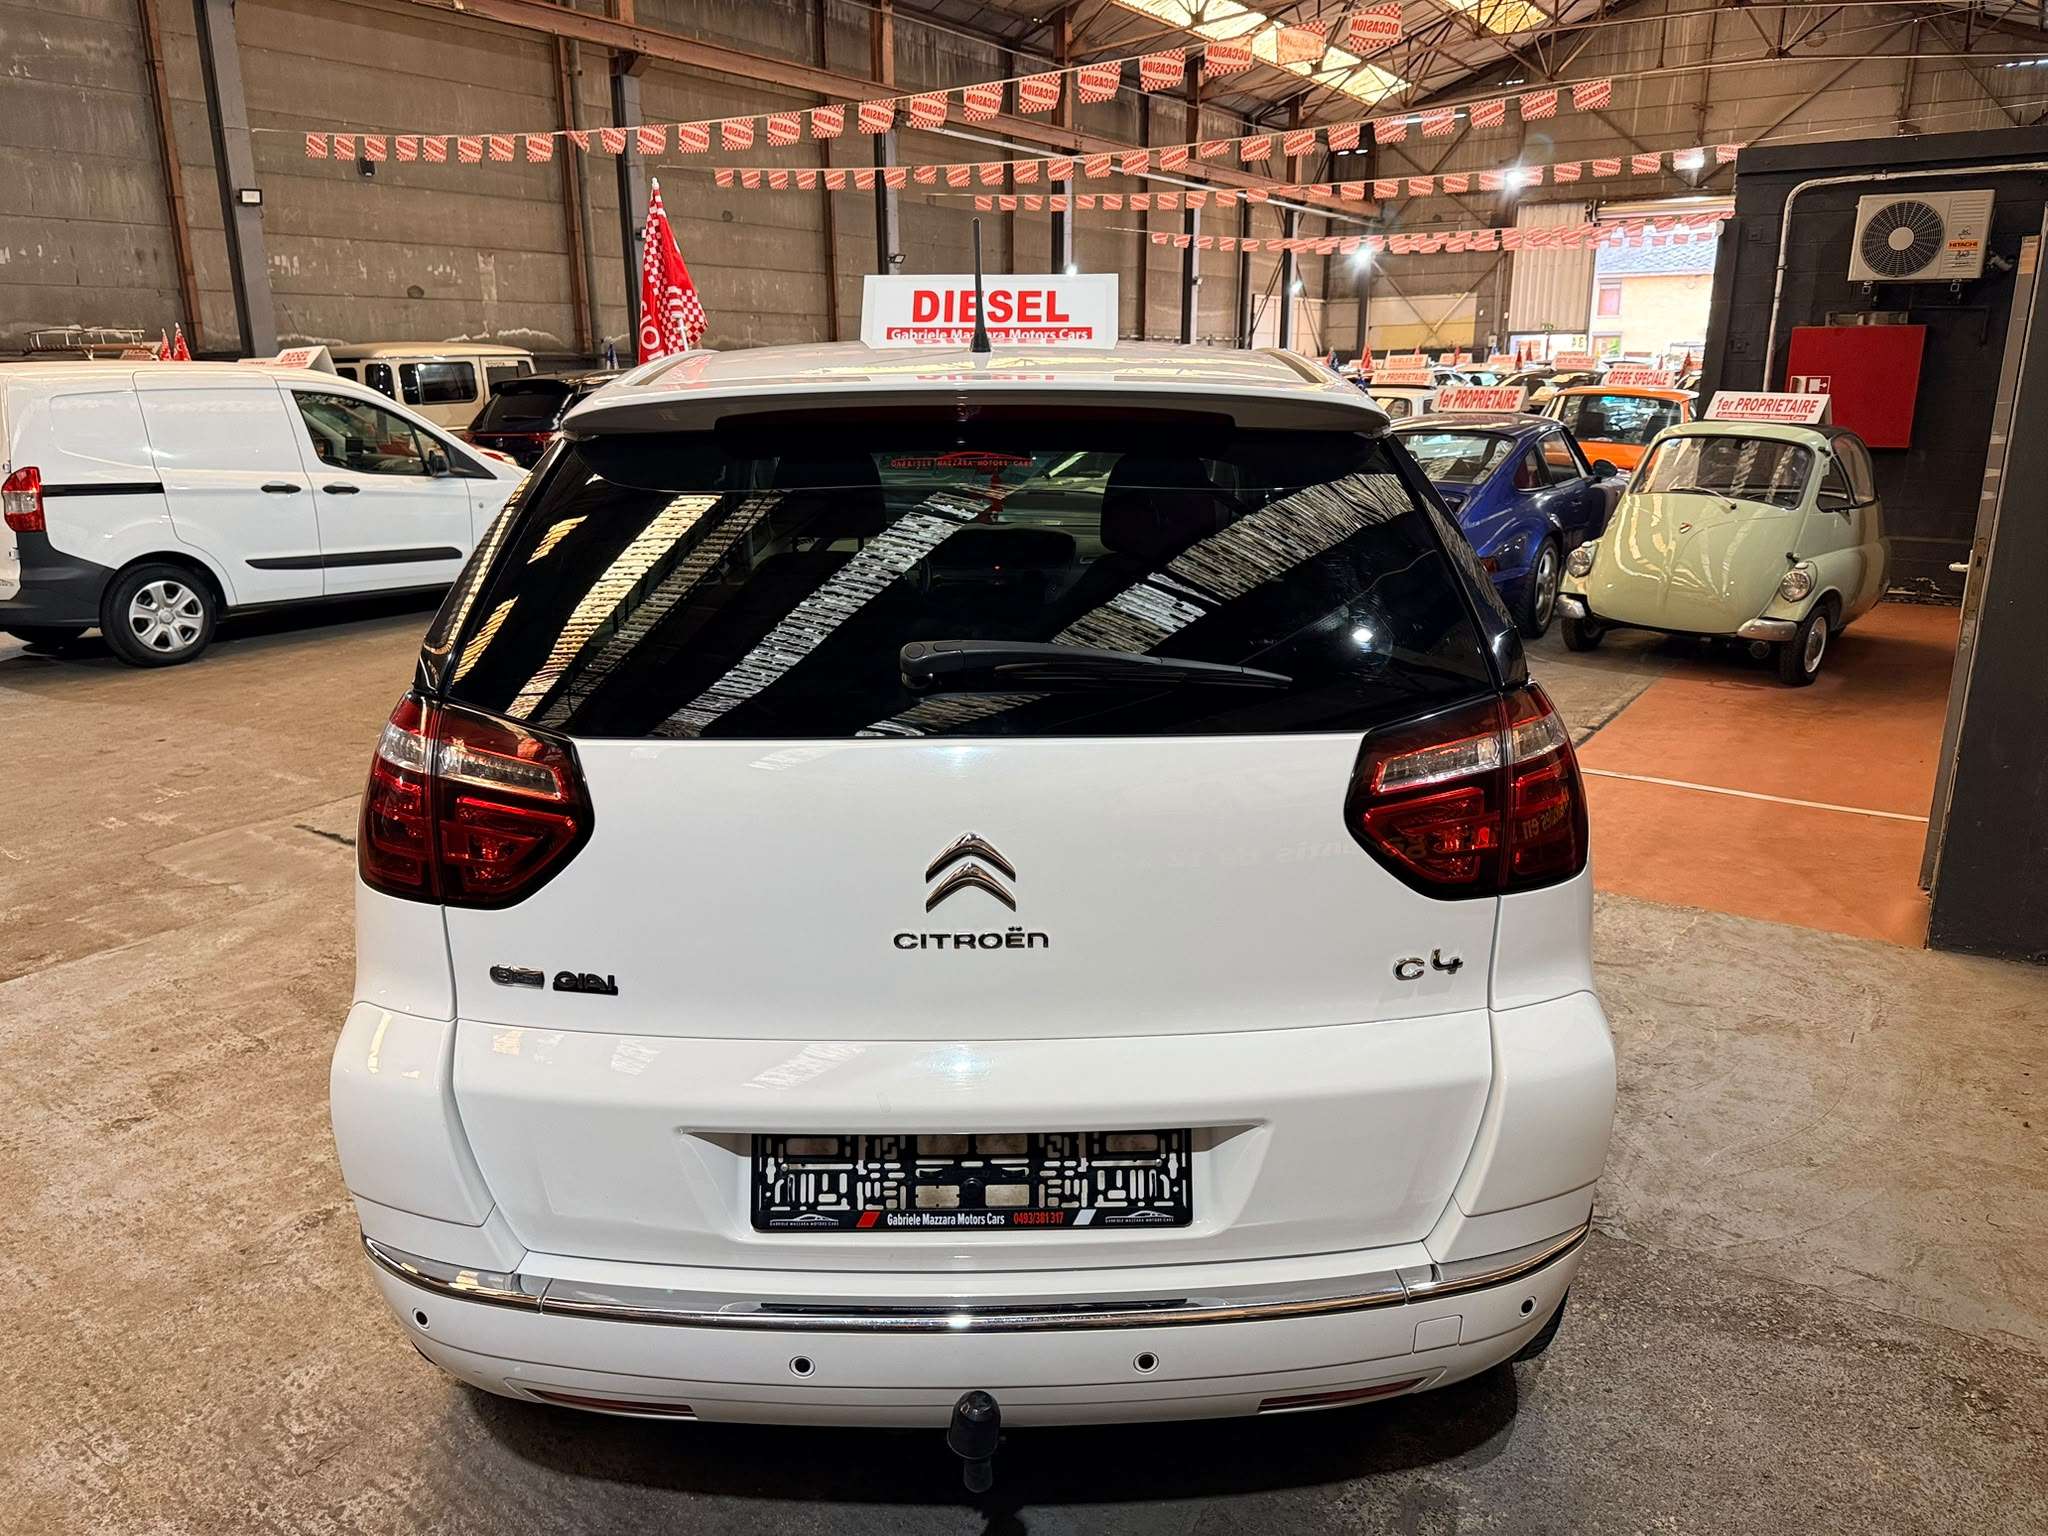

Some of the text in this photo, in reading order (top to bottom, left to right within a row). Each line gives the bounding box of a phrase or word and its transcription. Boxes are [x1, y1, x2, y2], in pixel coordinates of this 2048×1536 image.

[1522, 94, 1556, 116] OCCASION
[1575, 83, 1611, 106] OCCASION
[912, 290, 1070, 323] DIESEL
[891, 328, 1089, 340] Gabriele Maara Motors Cars
[1608, 371, 1669, 386] OFFRE SPECIALE
[1439, 388, 1520, 409] 1er PROPRIETAIRE
[1716, 396, 1819, 414] 1er PROPRIETAIRE
[1393, 947, 1464, 981] C4
[887, 1213, 921, 1226] Gabriele
[922, 1213, 956, 1225] Mazzara
[957, 1213, 986, 1225] Motors
[987, 1213, 1005, 1225] Cars
